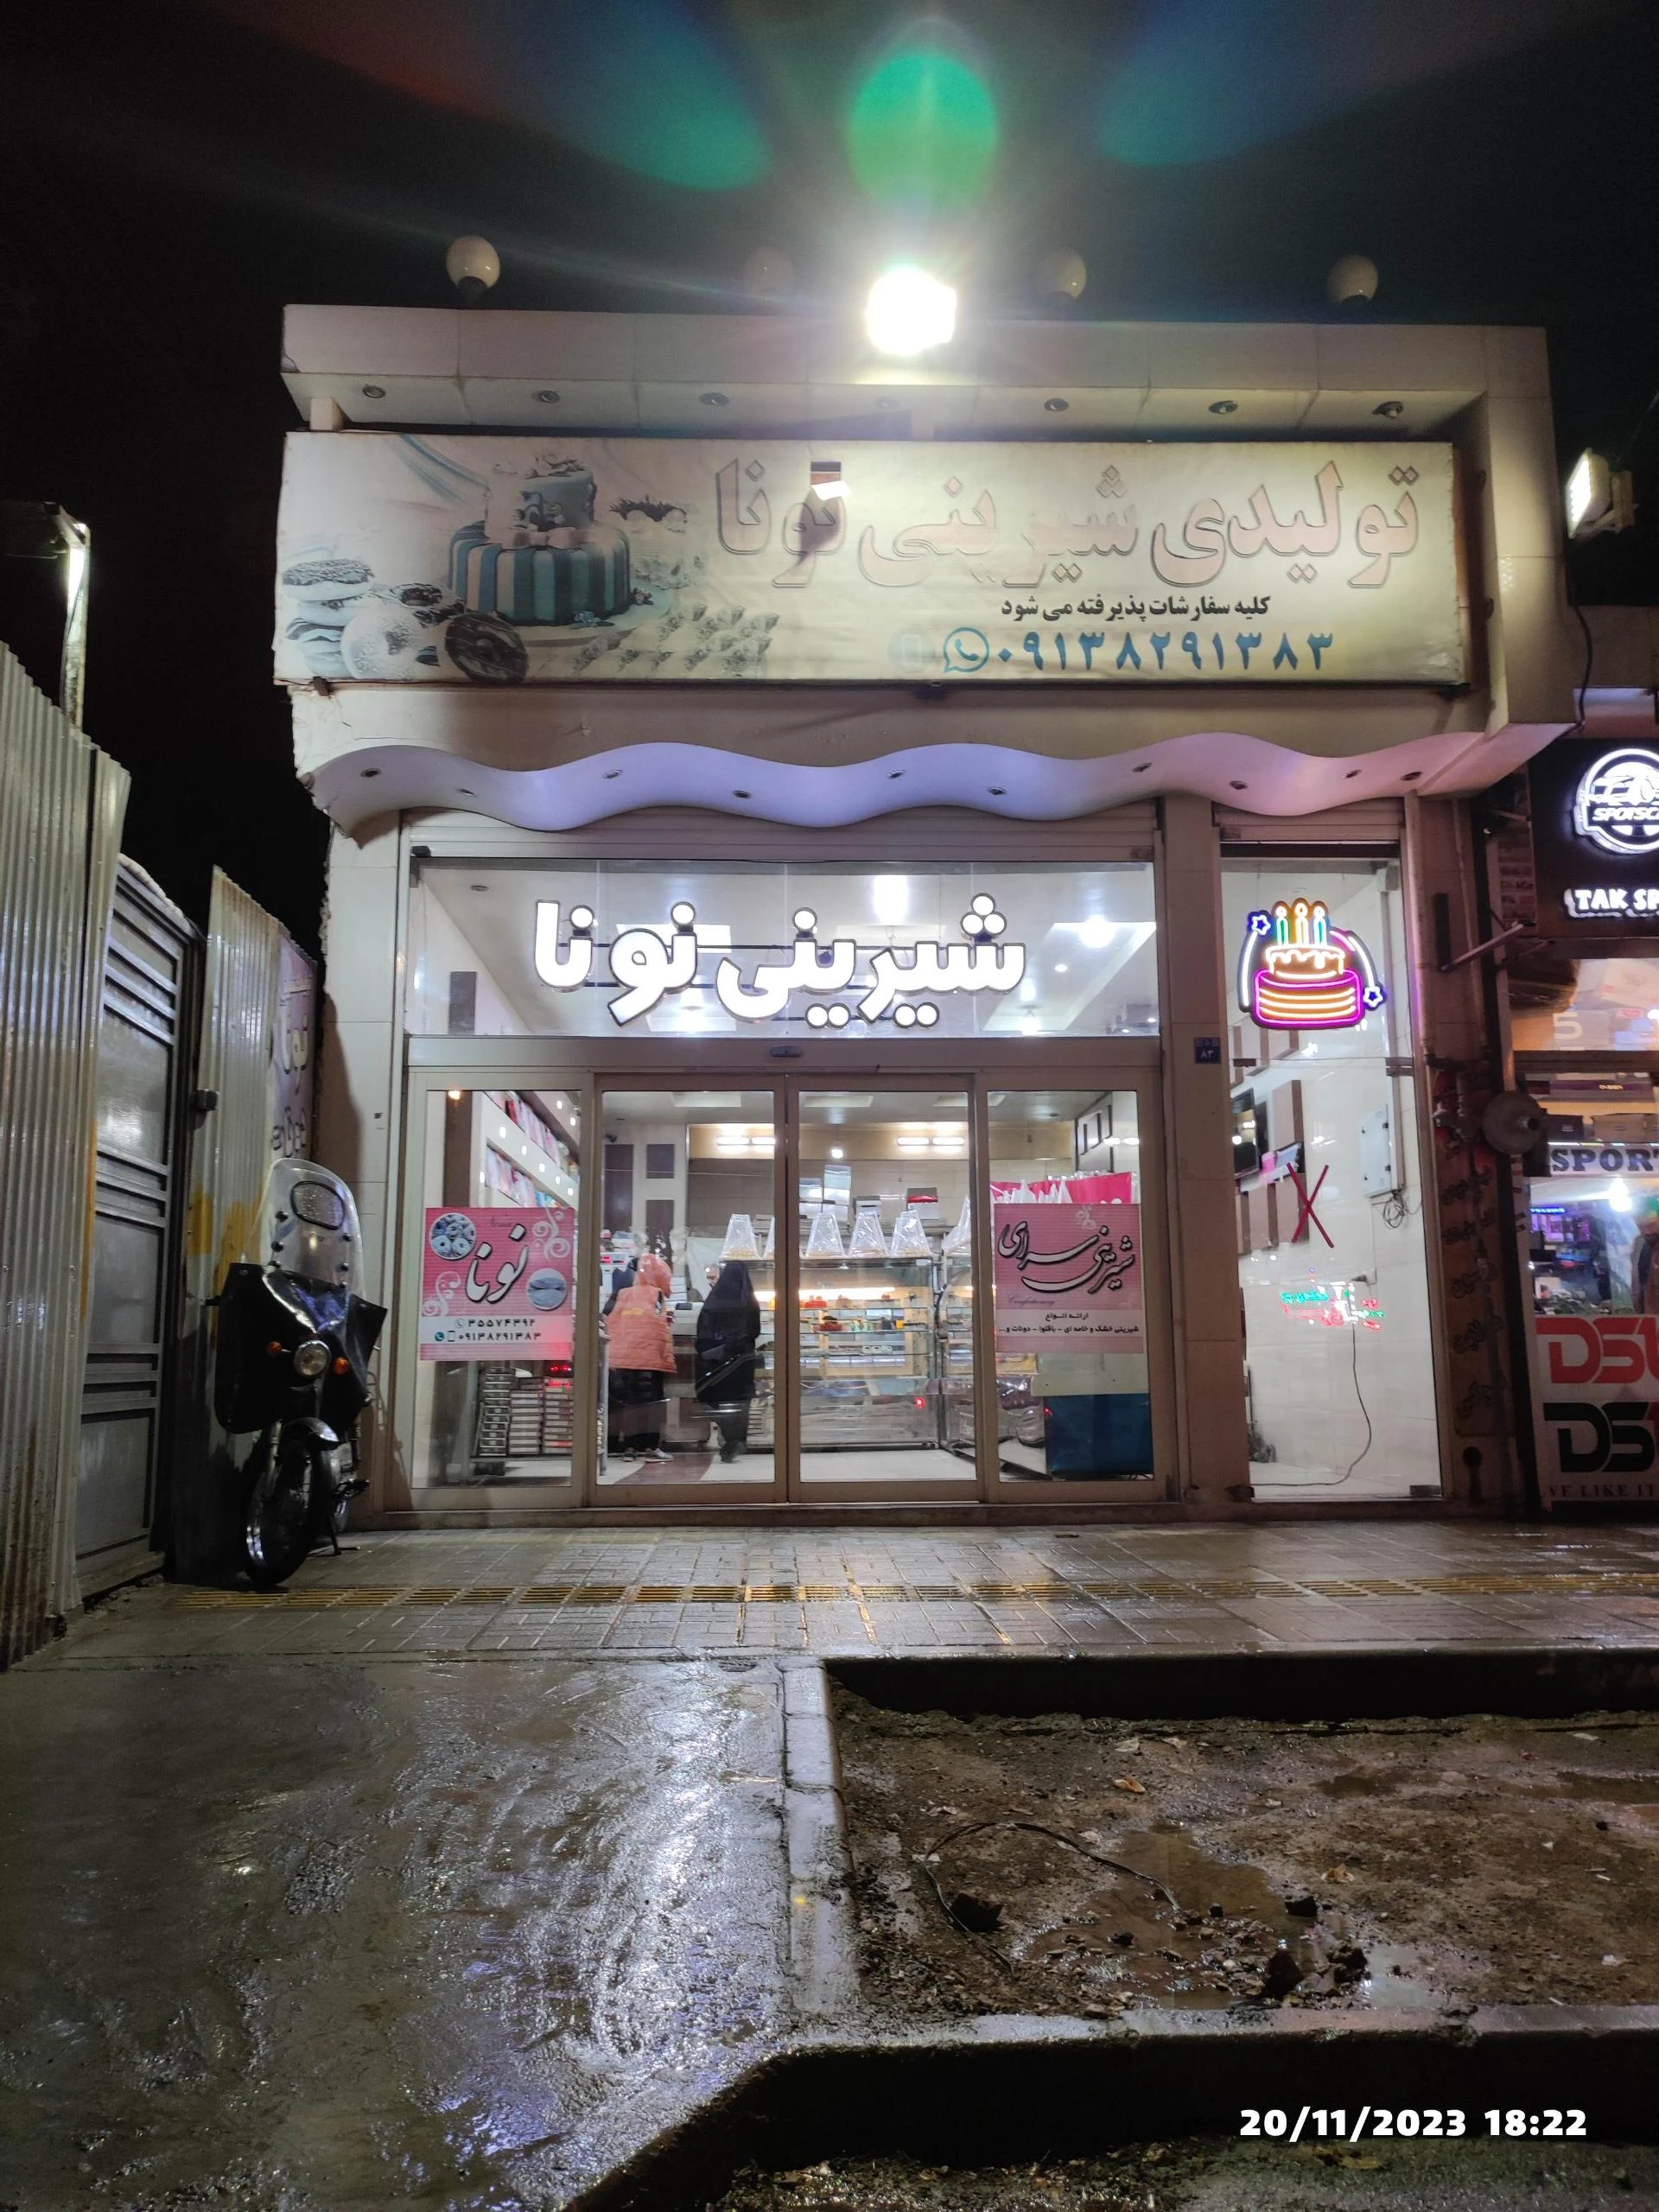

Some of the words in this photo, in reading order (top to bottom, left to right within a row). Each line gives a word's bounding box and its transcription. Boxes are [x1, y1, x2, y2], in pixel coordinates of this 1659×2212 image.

[857, 464, 1140, 588] شیرینی
[1151, 459, 1421, 589] تولیدی
[1001, 595, 1039, 622] شود
[1042, 602, 1073, 621] می
[1077, 594, 1146, 622] پذیرفته
[1148, 595, 1231, 622] سفارشات
[1234, 594, 1271, 621] کلیه
[997, 631, 1334, 671] ۰۹۱۳۸۲۹۱۳۸۳
[1573, 888, 1630, 911] TAK
[534, 899, 698, 1028] نونا
[715, 893, 1027, 1029] شیرینی
[466, 1223, 531, 1305] نونا
[1543, 1402, 1659, 1472] DS
